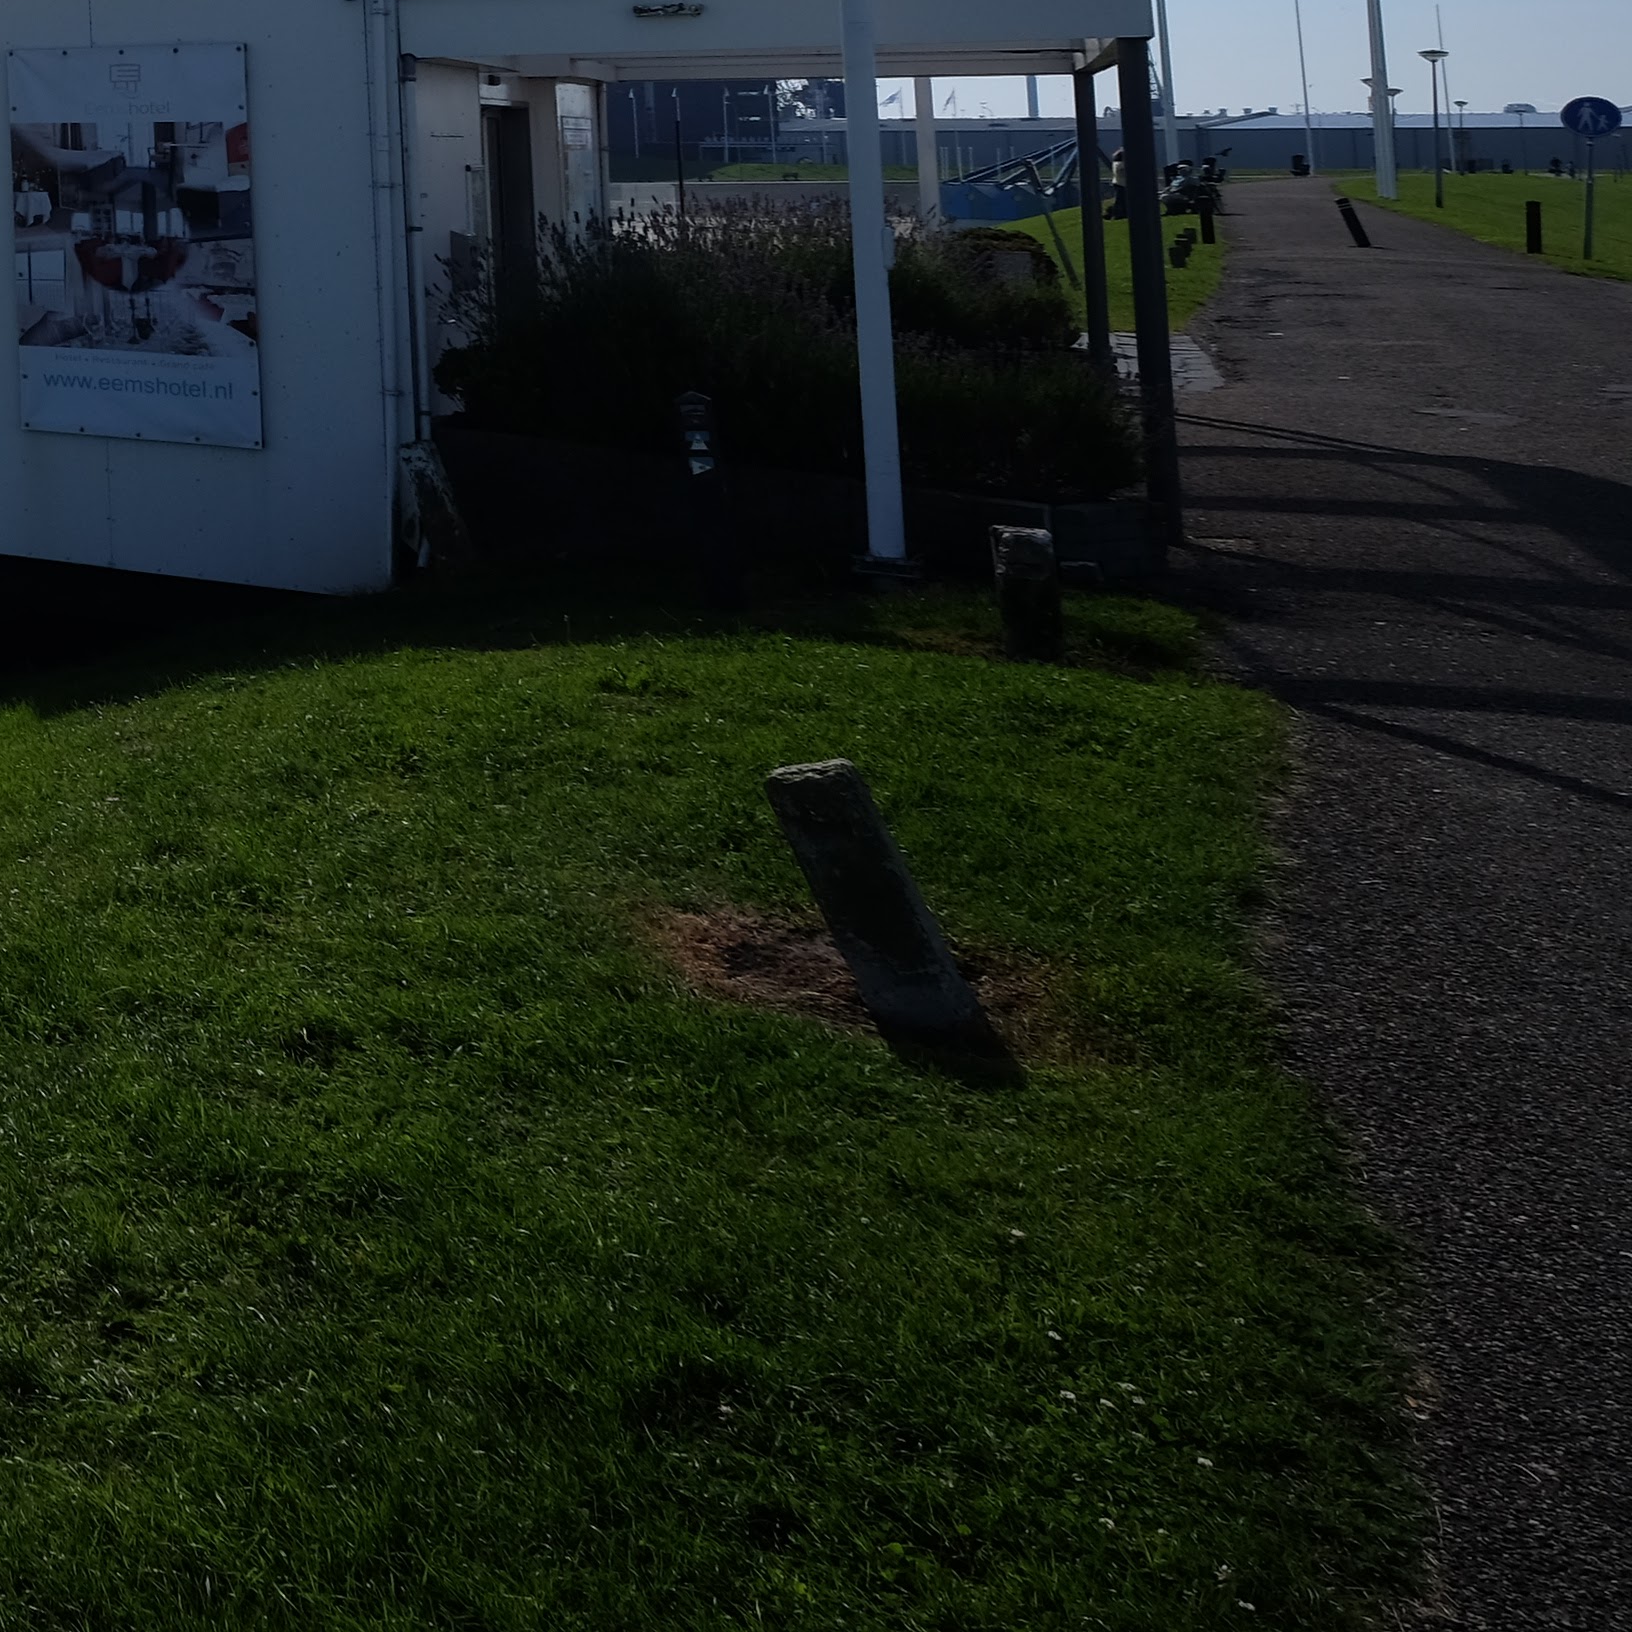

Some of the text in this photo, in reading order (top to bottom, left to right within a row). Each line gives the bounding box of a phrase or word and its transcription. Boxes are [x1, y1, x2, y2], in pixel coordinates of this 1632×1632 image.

[85, 100, 170, 115] Eemhotel
[55, 352, 81, 362] Hotel
[93, 354, 147, 366] Restaurant
[43, 373, 233, 400] www.eemshotel.nl
